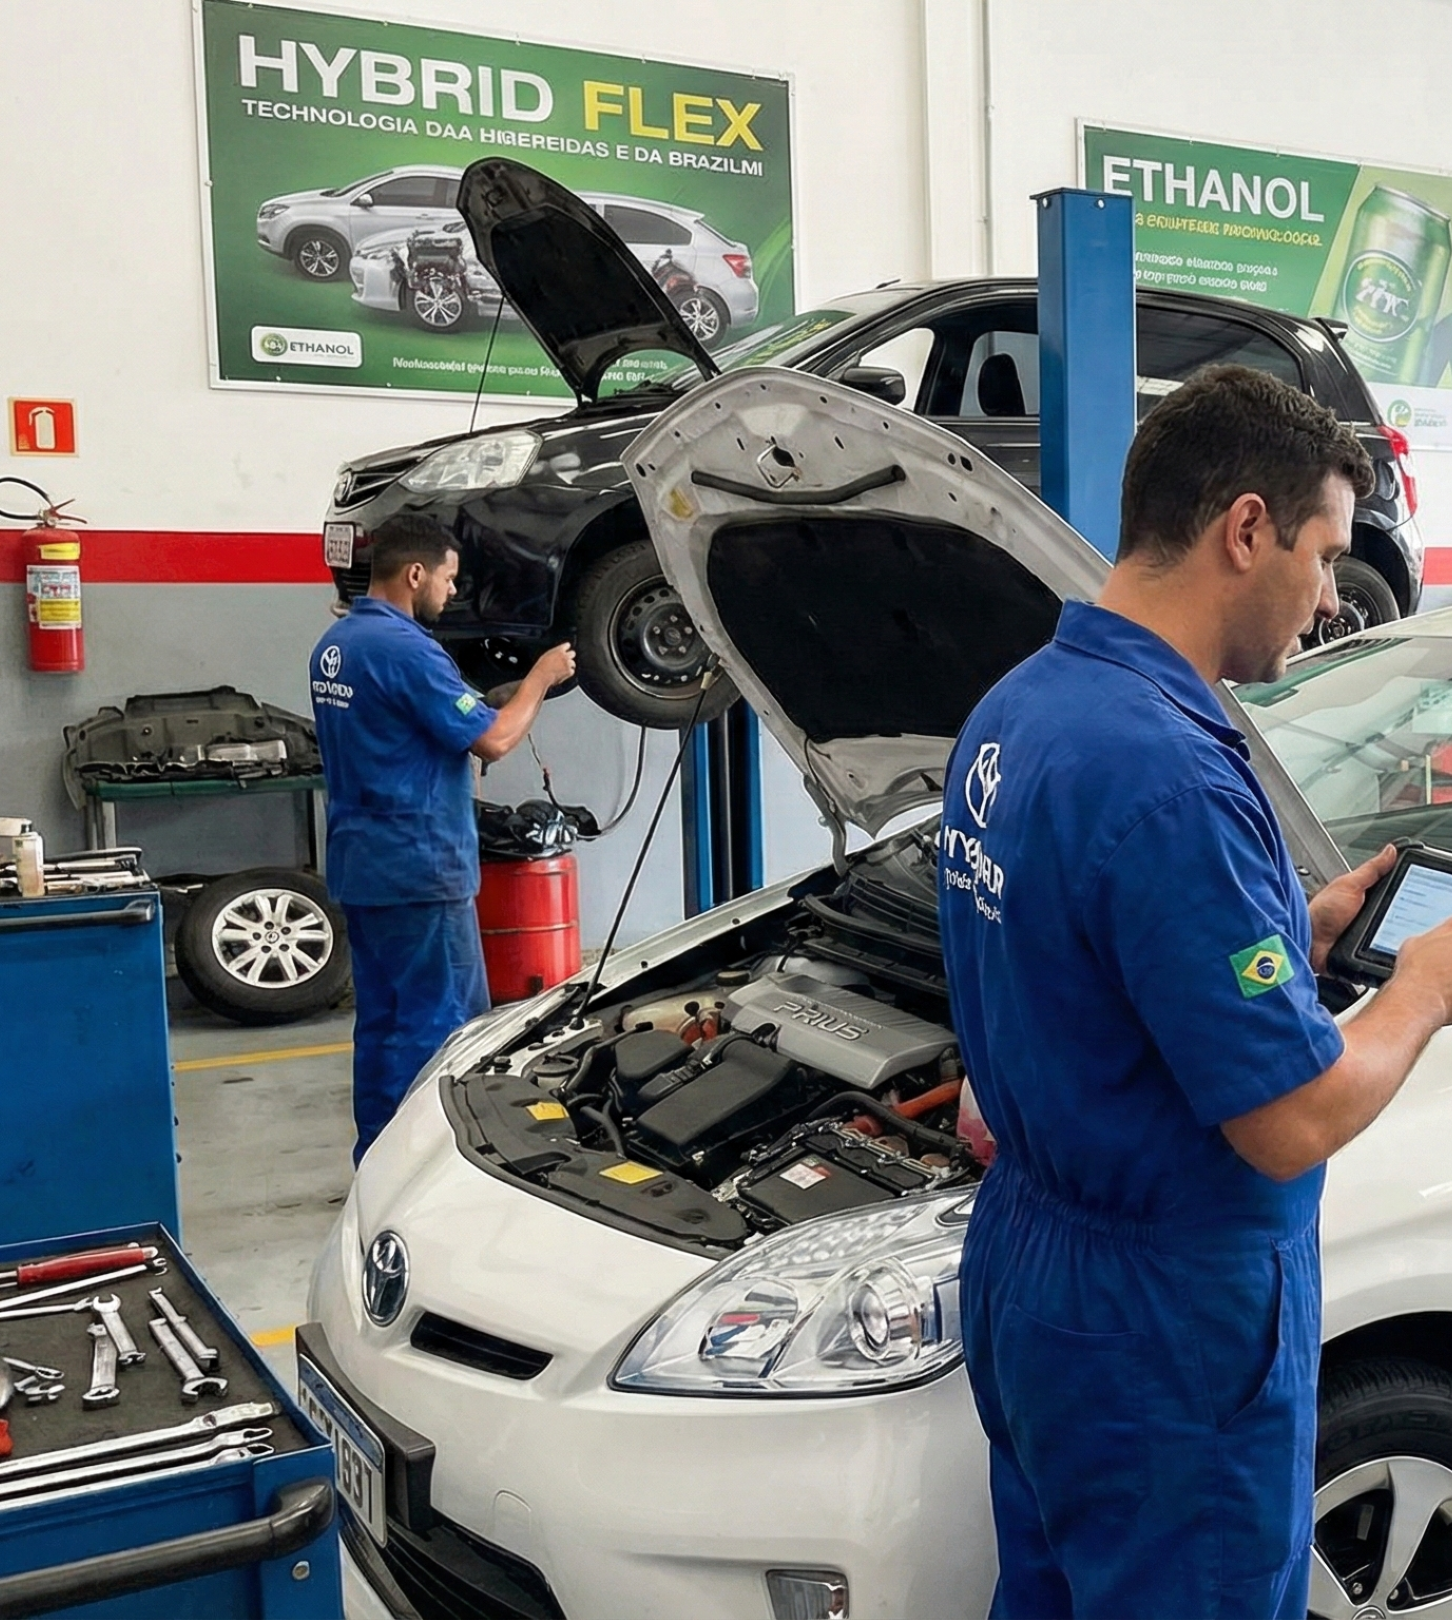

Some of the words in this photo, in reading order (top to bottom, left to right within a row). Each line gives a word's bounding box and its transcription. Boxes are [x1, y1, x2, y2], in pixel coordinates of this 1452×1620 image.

[237, 33, 554, 123] HYBRID
[582, 80, 764, 152] FLEX
[241, 98, 418, 135] TECHNOLOGIA
[425, 120, 472, 142] DAA
[616, 145, 630, 160] E
[635, 147, 663, 165] DA
[669, 151, 764, 177] BRAZILMI
[1103, 155, 1325, 222] ETHANOL
[290, 341, 354, 355] ETHANOL
[773, 1001, 870, 1040] PRIUS
